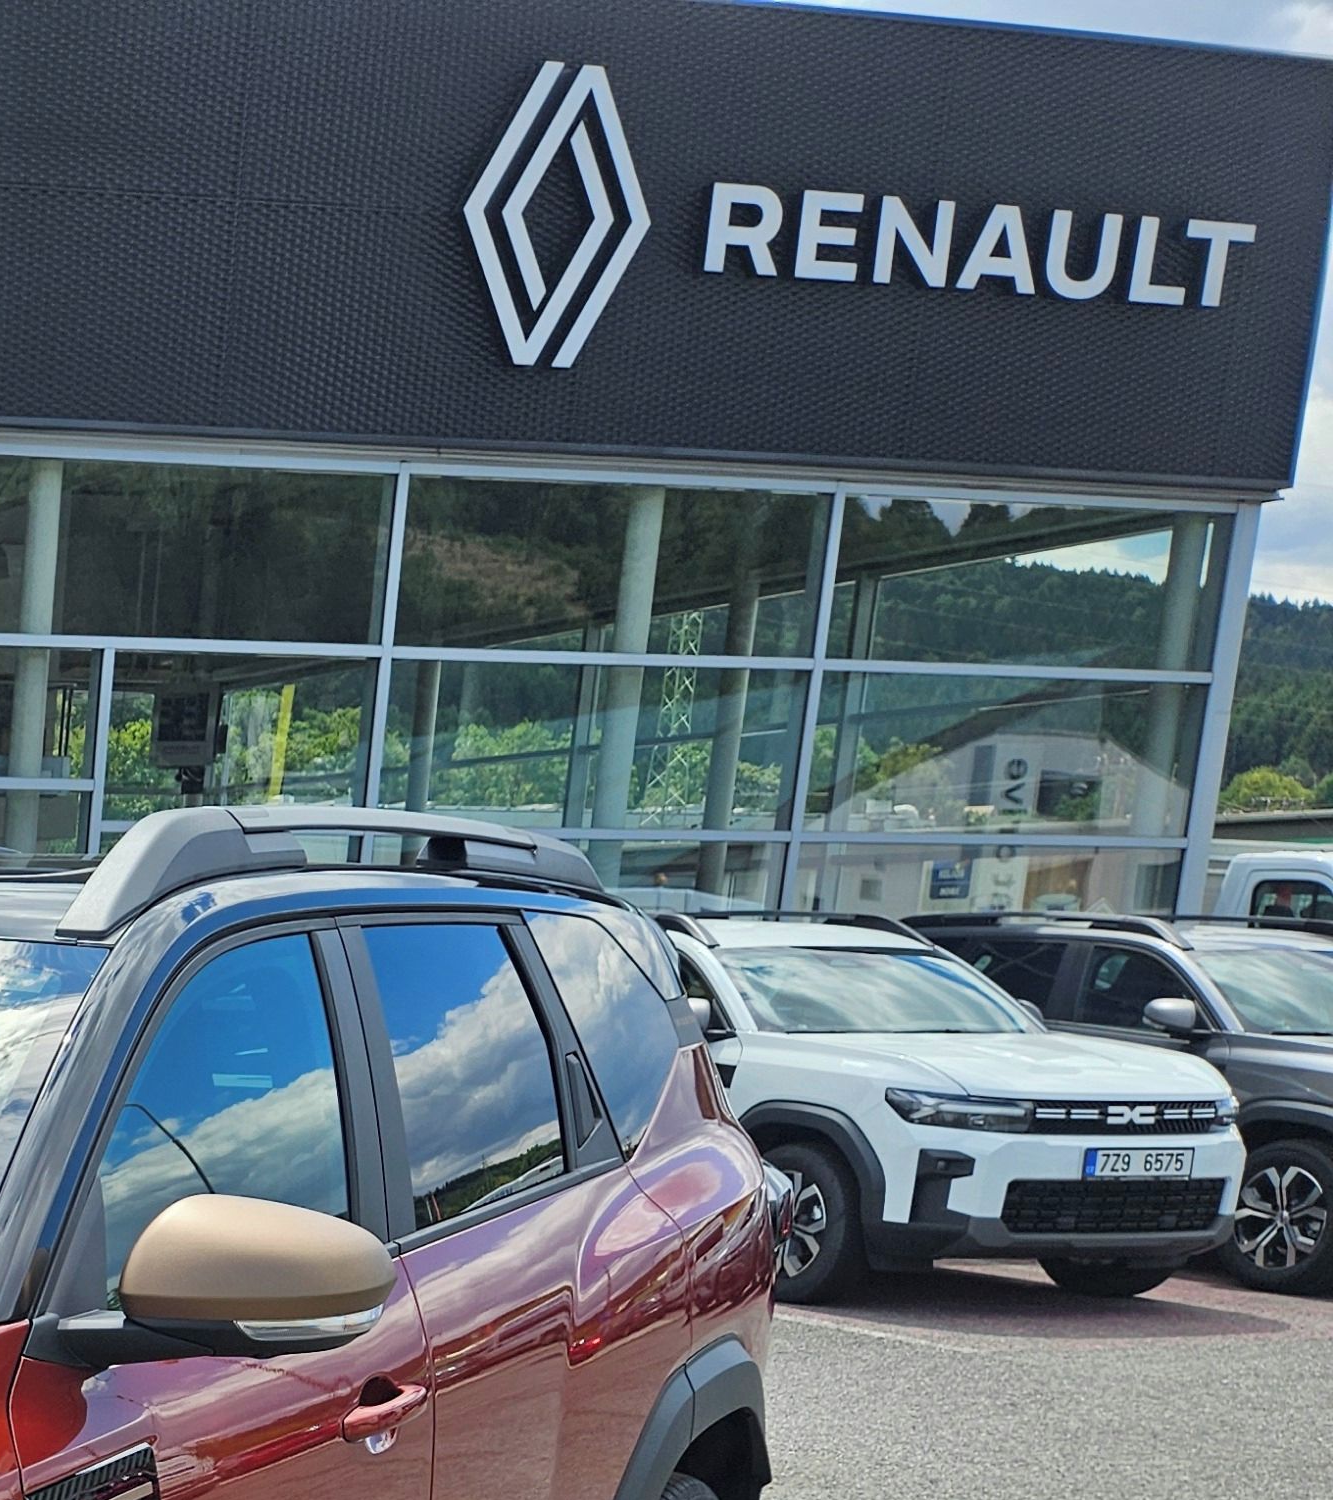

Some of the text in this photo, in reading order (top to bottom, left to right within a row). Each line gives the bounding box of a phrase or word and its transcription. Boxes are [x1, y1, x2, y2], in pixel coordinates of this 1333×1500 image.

[702, 182, 1257, 307] RENAULT
[1100, 1153, 1131, 1173] 7Z9
[1144, 1153, 1185, 1173] 6575
